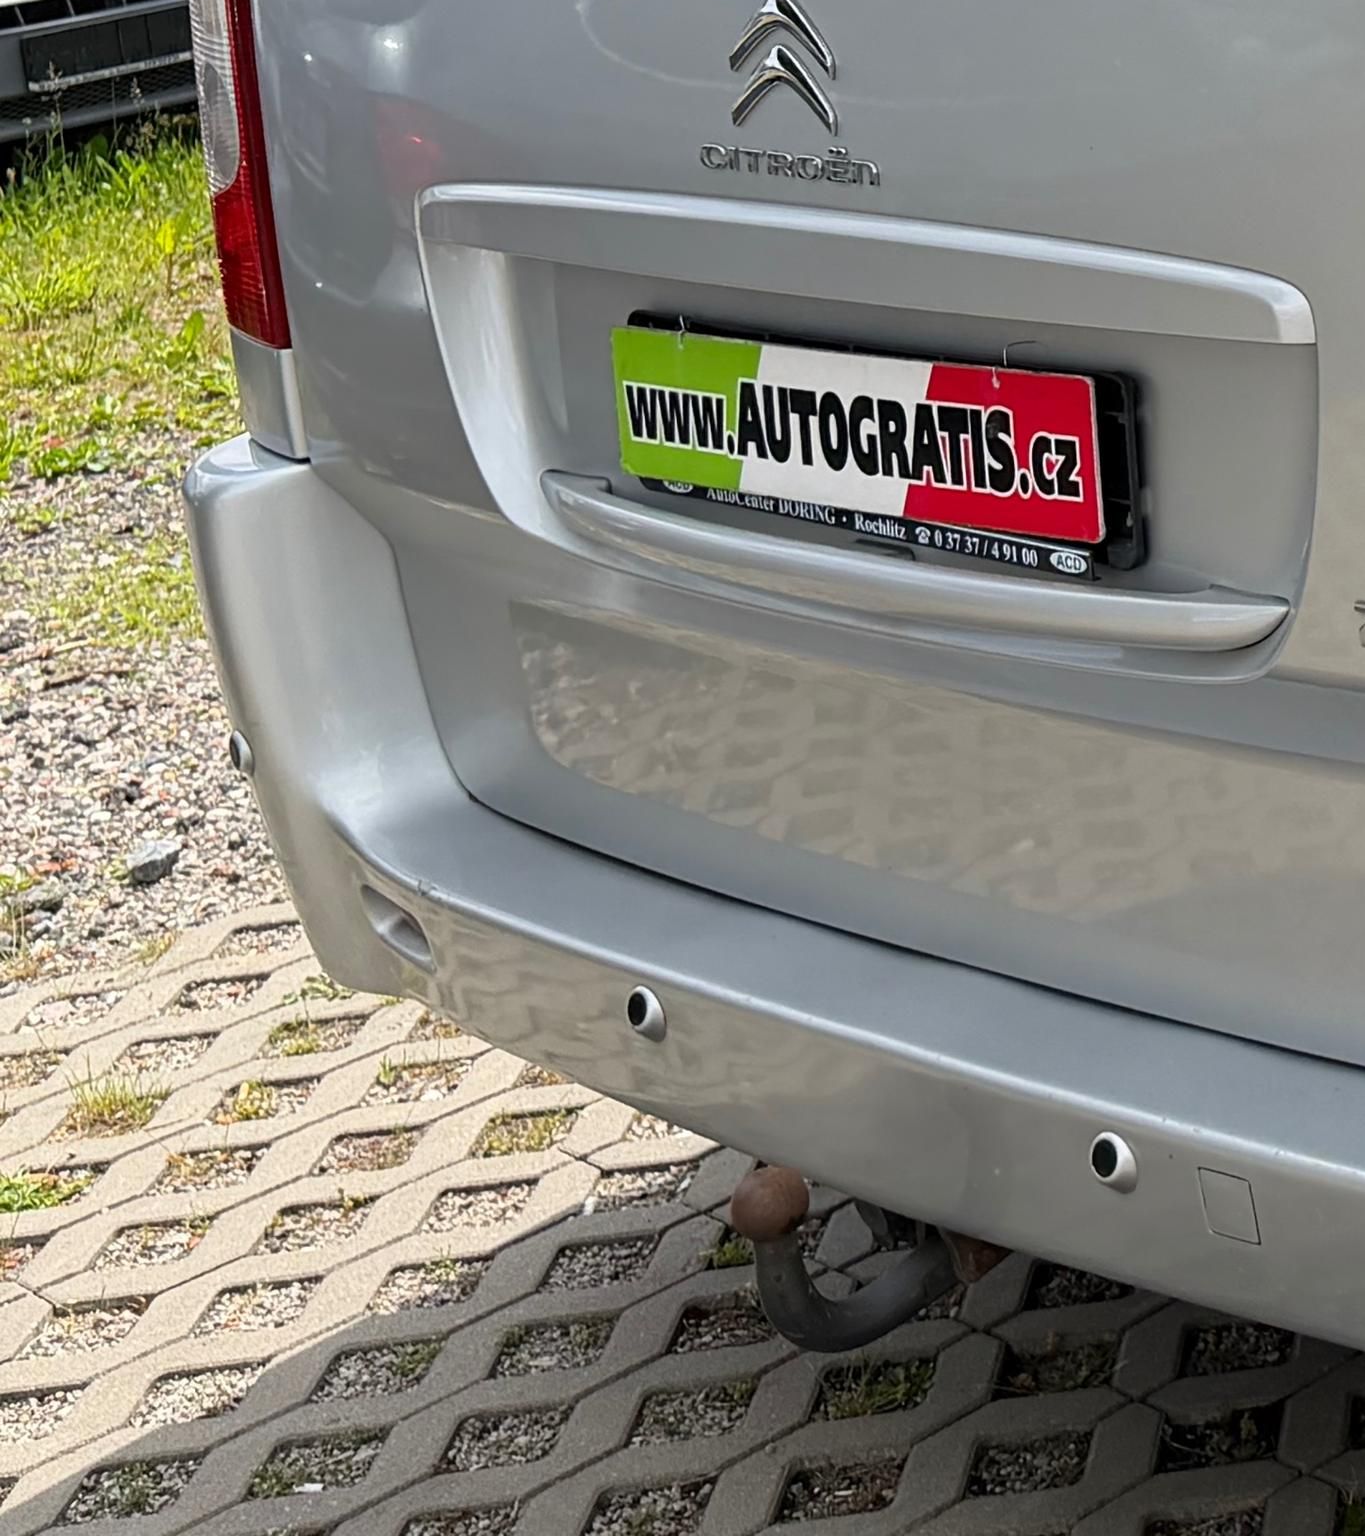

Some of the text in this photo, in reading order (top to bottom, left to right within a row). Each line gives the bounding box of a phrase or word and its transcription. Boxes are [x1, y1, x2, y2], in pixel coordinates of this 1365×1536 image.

[855, 512, 908, 540] Rochlitz
[946, 531, 960, 551] 37
[964, 535, 980, 554] 37
[1003, 543, 1018, 563] 91
[1021, 547, 1039, 568] 00
[1056, 554, 1082, 571] ACD
